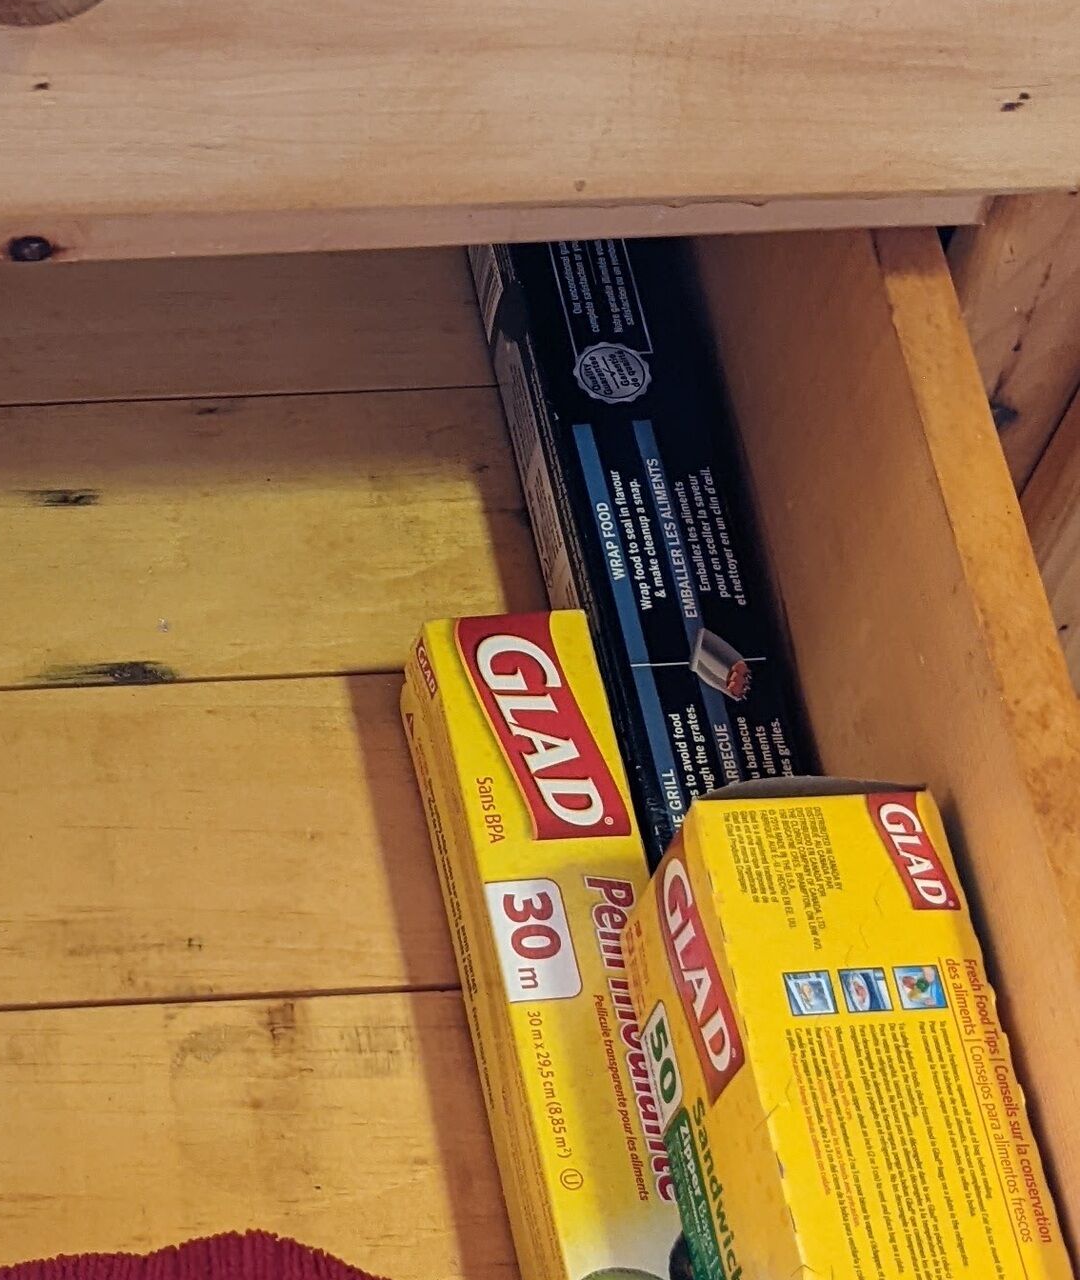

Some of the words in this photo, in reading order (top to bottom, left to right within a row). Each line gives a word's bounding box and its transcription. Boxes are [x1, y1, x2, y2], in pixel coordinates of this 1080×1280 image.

[611, 471, 626, 505] flavour
[630, 479, 643, 505] snap.
[647, 459, 672, 519] ALIMENTS
[689, 475, 704, 507] saveur
[619, 507, 630, 517] in
[675, 482, 693, 524] aliments
[697, 509, 708, 518] la
[710, 497, 721, 514] clin
[596, 503, 615, 537] FOOD
[621, 519, 636, 539] seal
[664, 522, 680, 545] LES
[687, 526, 698, 541] les
[716, 517, 726, 530] un
[628, 542, 639, 553] to
[639, 516, 656, 556] cleanup
[702, 521, 717, 555] sceller
[720, 532, 730, 545] en
[606, 541, 625, 580] WRAP
[630, 556, 645, 580] food
[649, 559, 663, 587] make
[692, 545, 711, 591] Emballez
[711, 558, 721, 570] en
[724, 548, 742, 591] nettoyer
[639, 582, 652, 610] Wrap
[654, 589, 666, 598] &
[671, 549, 697, 617] EMBALLER
[715, 573, 731, 597] pour
[734, 594, 746, 605] et
[418, 646, 436, 693] GLAD
[668, 714, 685, 738] food
[686, 704, 705, 742] grates.
[771, 718, 790, 755] grilles.
[675, 742, 693, 771] avoid
[695, 745, 707, 764] the
[737, 717, 757, 768] barbecue
[755, 726, 775, 774] aliments
[476, 777, 495, 811] Sans
[662, 769, 682, 810] GRILL
[686, 774, 697, 786] to
[485, 814, 505, 843] BPA
[503, 891, 561, 959] 30
[518, 967, 538, 989] m
[964, 959, 983, 991] Fresh
[527, 1011, 542, 1026] 30
[594, 995, 611, 1037] Pellicule
[974, 995, 993, 1025] Food
[531, 1029, 542, 1040] m
[984, 1029, 1000, 1055] Tips
[536, 1052, 554, 1078] 29,5
[604, 1040, 627, 1107] transparente
[646, 1018, 676, 1103] 50
[543, 1081, 556, 1099] cm
[946, 959, 959, 979] des
[953, 983, 976, 1035] aliments
[970, 1046, 993, 1099] Consejos
[982, 1103, 1001, 1130] para
[994, 1134, 1019, 1193] alimentos
[1012, 1198, 1032, 1242] frescos
[995, 1065, 1019, 1117] Conseils
[546, 1102, 566, 1134] (8,85
[618, 1110, 632, 1134] pour
[1009, 1121, 1024, 1140] sur
[626, 1137, 637, 1151] les
[680, 1122, 701, 1195] Zipper
[1016, 1144, 1029, 1155] la
[631, 1153, 649, 1200] aliments
[1021, 1159, 1051, 1243] conservation
